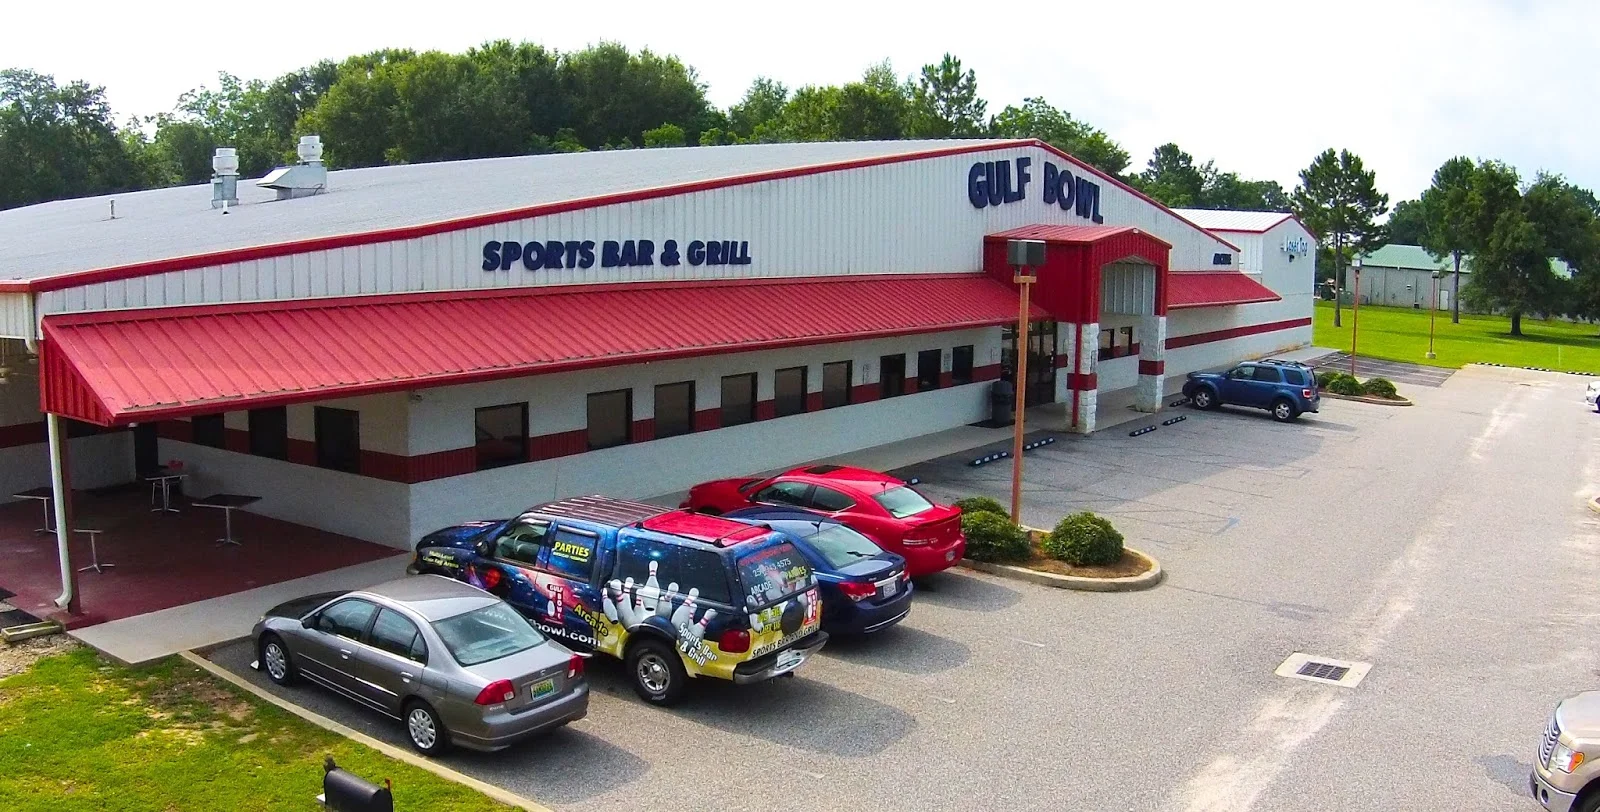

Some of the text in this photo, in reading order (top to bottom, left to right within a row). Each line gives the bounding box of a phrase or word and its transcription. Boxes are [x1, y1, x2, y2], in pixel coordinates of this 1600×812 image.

[968, 157, 1104, 225] GULF BOWL
[482, 240, 752, 271] SPORTS BAR & GRILL
[553, 541, 590, 558] PARTIES
[750, 581, 773, 596] ARCADE
[574, 603, 608, 636] Arcade
[678, 622, 718, 661] Sports Bar
[680, 640, 706, 667] & Grill
[752, 642, 776, 658] SPORTS
